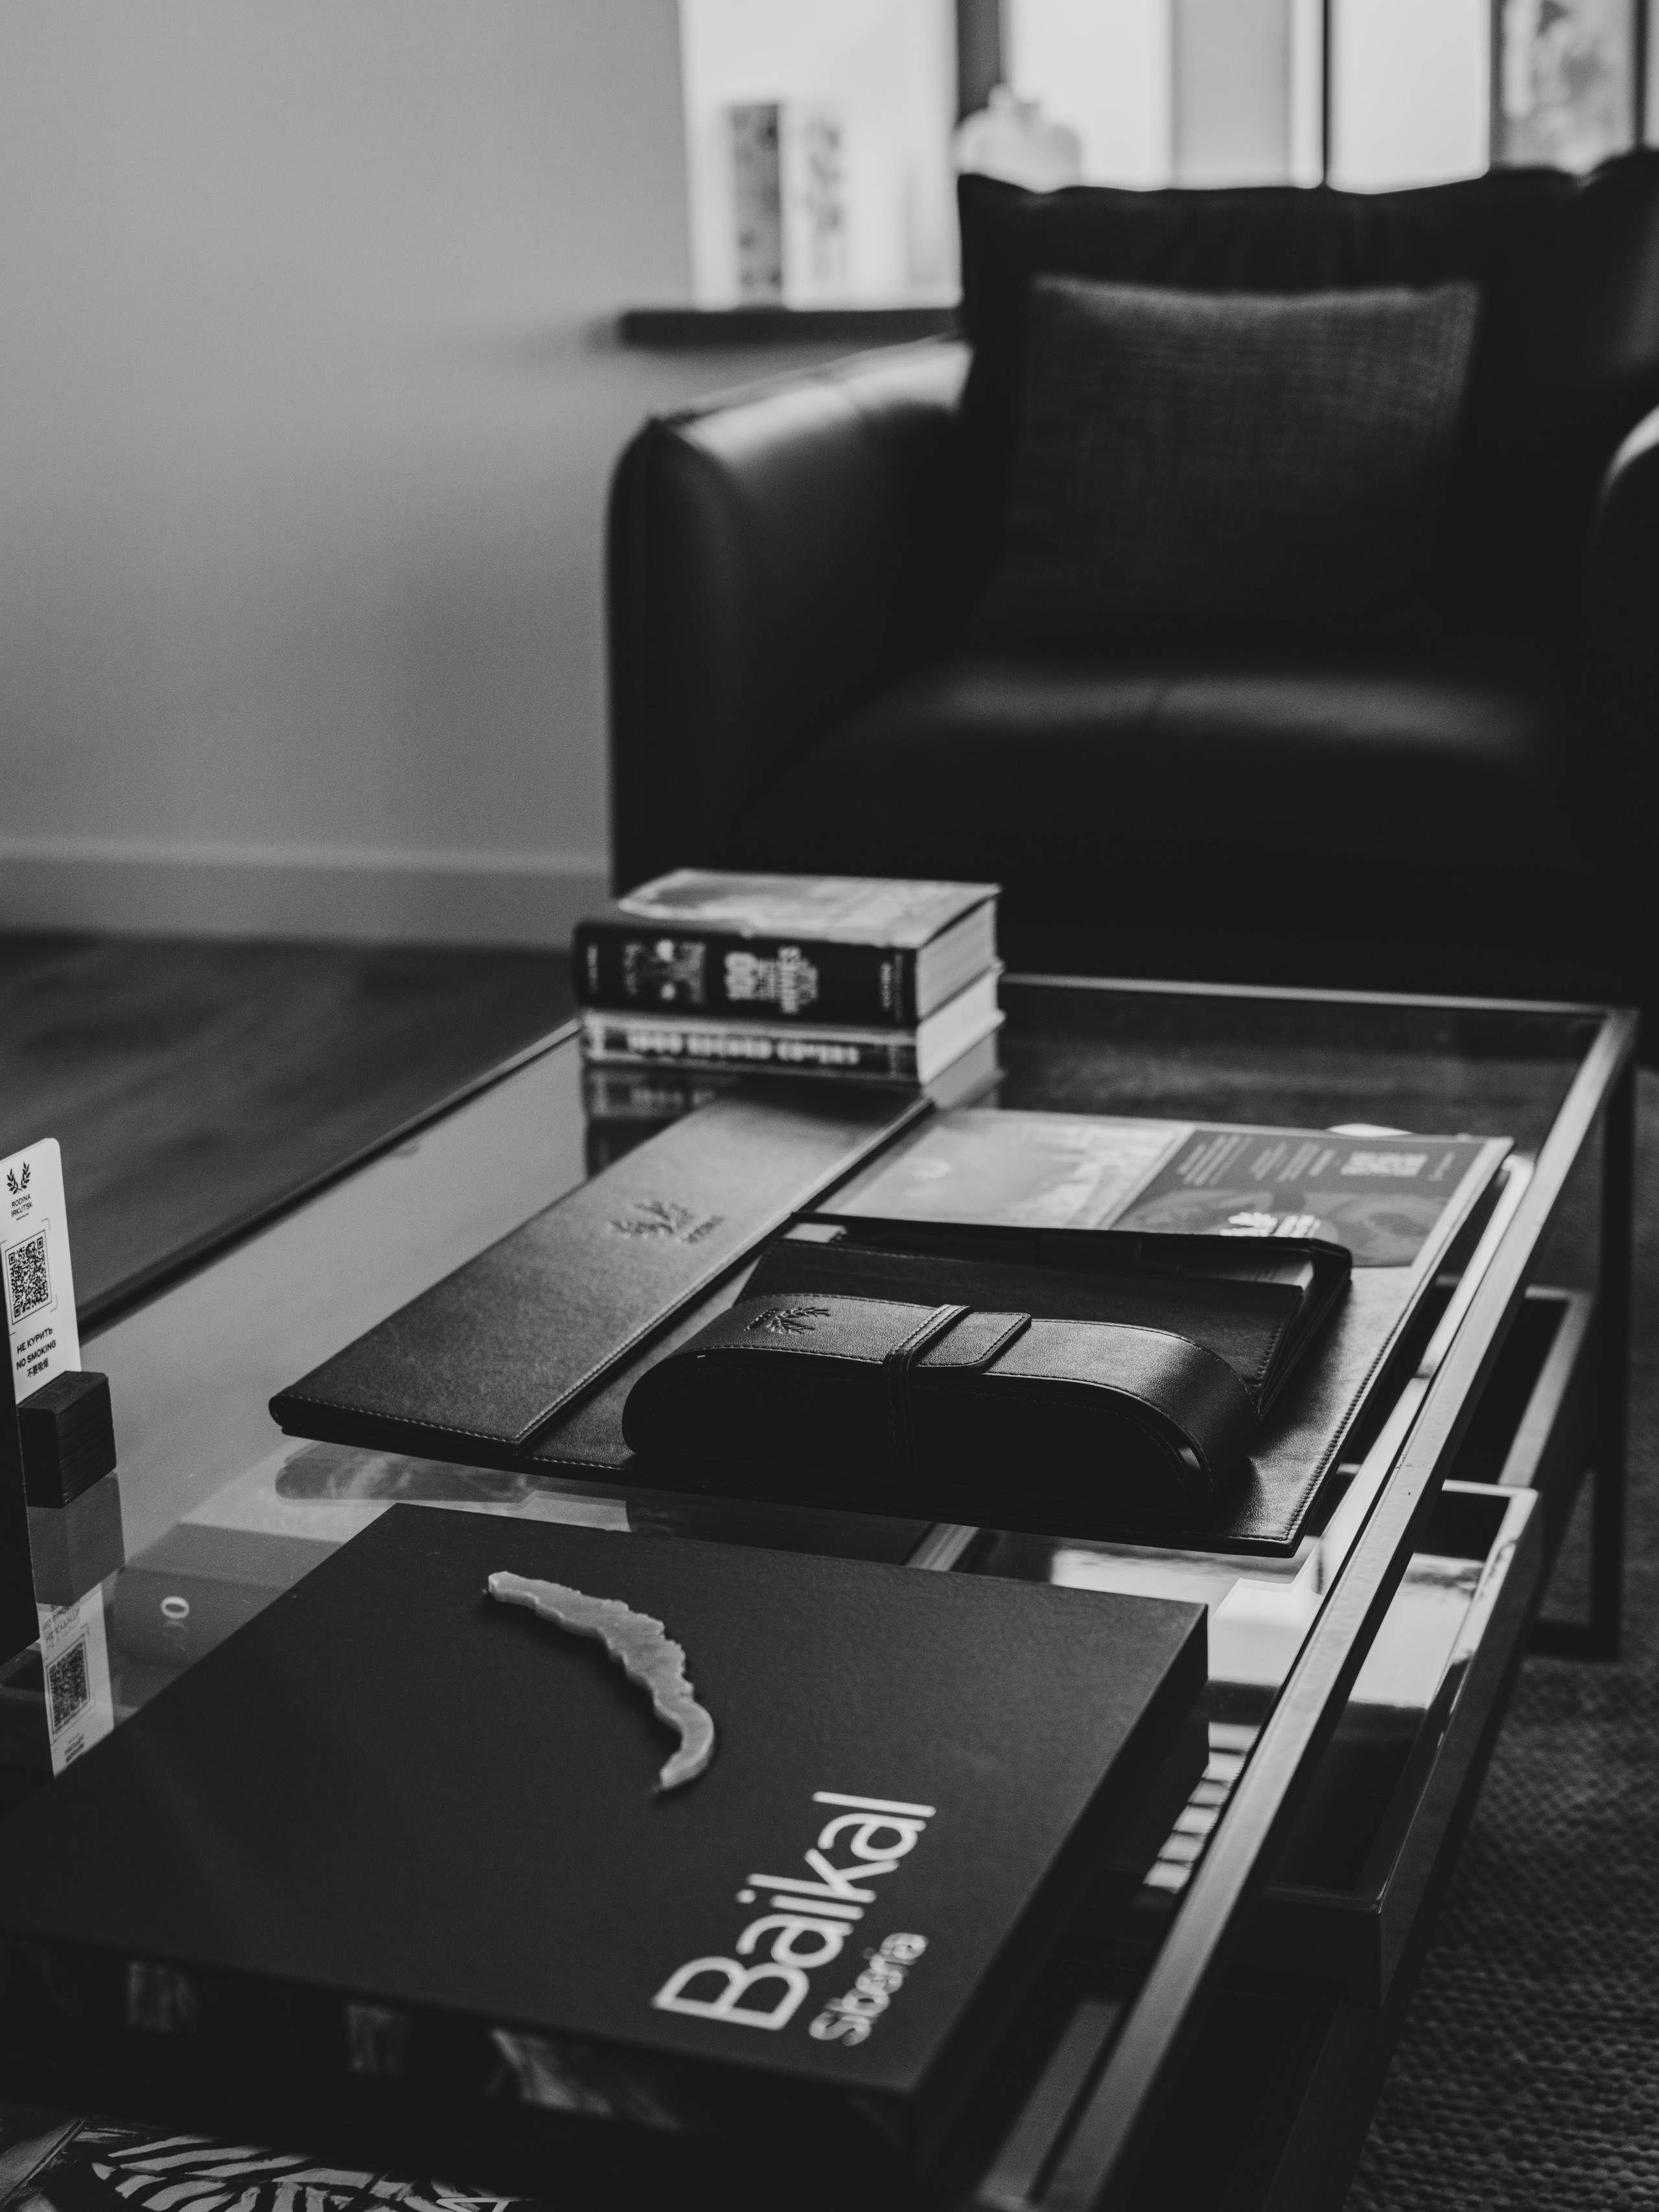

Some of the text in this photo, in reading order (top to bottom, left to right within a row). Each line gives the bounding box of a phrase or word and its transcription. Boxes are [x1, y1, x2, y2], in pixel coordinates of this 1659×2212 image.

[11, 1201, 33, 1217] IRKUTSK
[12, 1194, 31, 1208] RODINA
[17, 1327, 53, 1354] НЕ КУРИТЬ
[16, 1340, 56, 1370] NO SMOKING
[652, 1791, 936, 2031] Baikal
